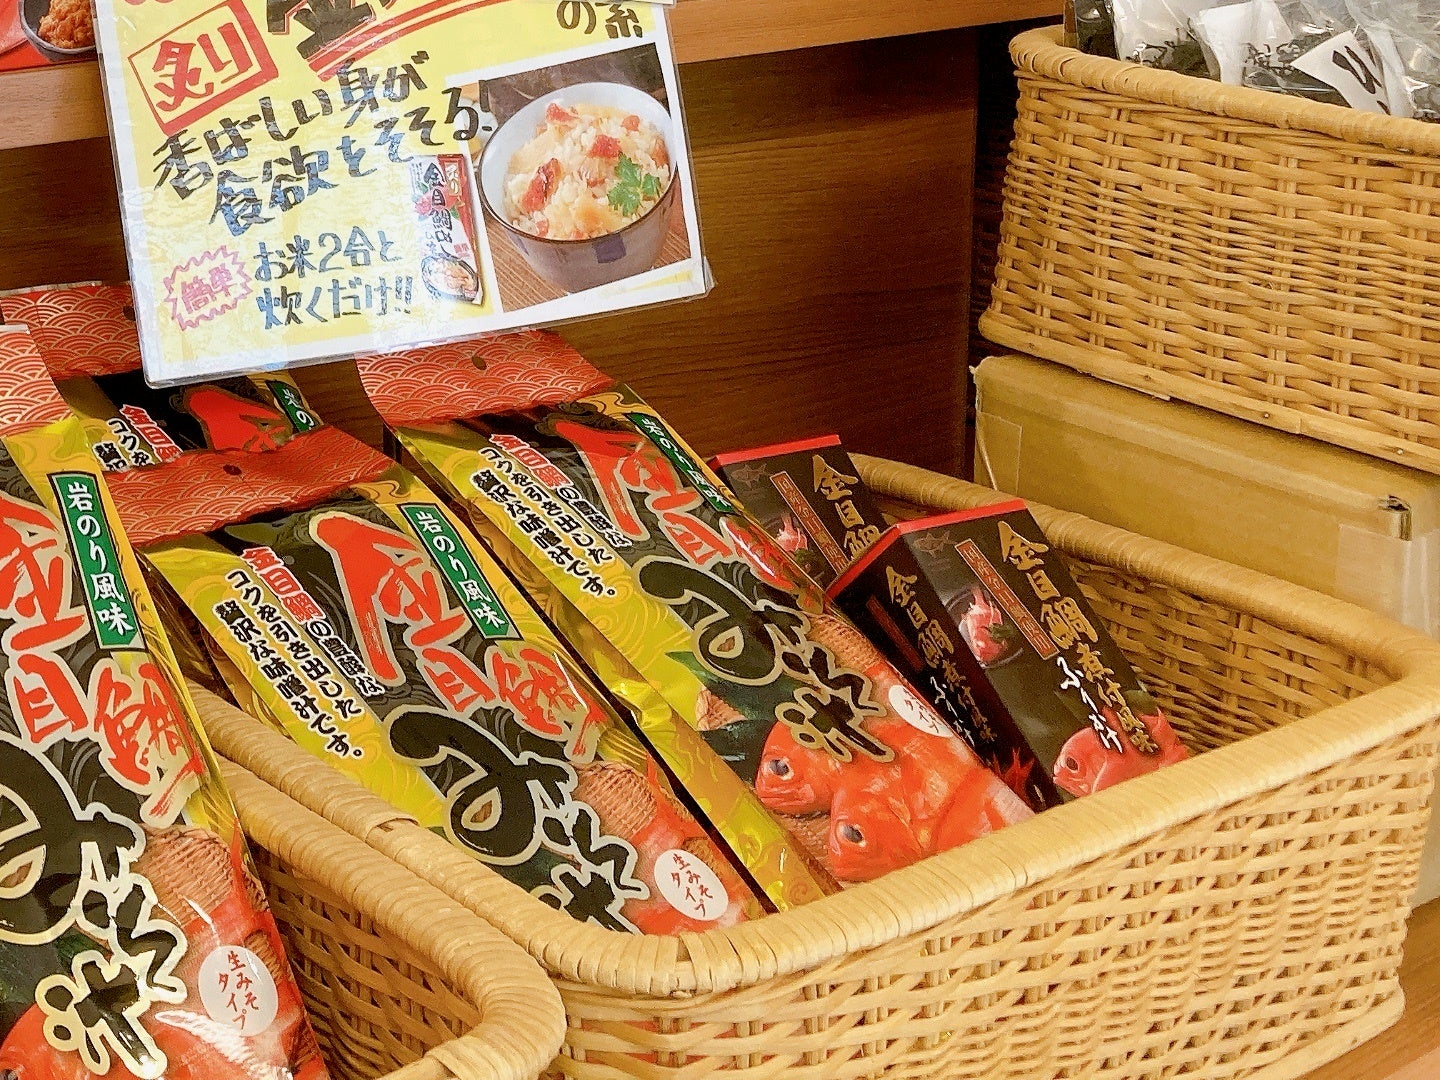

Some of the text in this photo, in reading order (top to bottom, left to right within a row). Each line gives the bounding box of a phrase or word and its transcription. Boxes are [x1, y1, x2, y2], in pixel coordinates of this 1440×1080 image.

[152, 21, 254, 112] 炙り
[153, 51, 430, 200] 香ばしい身が
[180, 265, 238, 314] 簡単
[255, 226, 403, 282] お米2合と
[64, 481, 136, 637] 岩のり風味
[470, 468, 618, 599] 贅沢な味噌汁です。
[477, 446, 614, 567] コクを引き出した
[415, 508, 506, 632] 岩のり風味
[212, 598, 365, 759] 贅沢な味噌汁です。
[224, 568, 364, 720] コクを引き出した
[308, 510, 607, 764] 金目鯛
[997, 520, 1161, 754] 金目鯛煮付風味
[1056, 656, 1124, 754] ふりかけ
[668, 867, 709, 919] タイプ
[672, 851, 714, 902] 生みそ
[217, 973, 249, 1031] タイプ
[227, 949, 260, 1013] 生みそ
